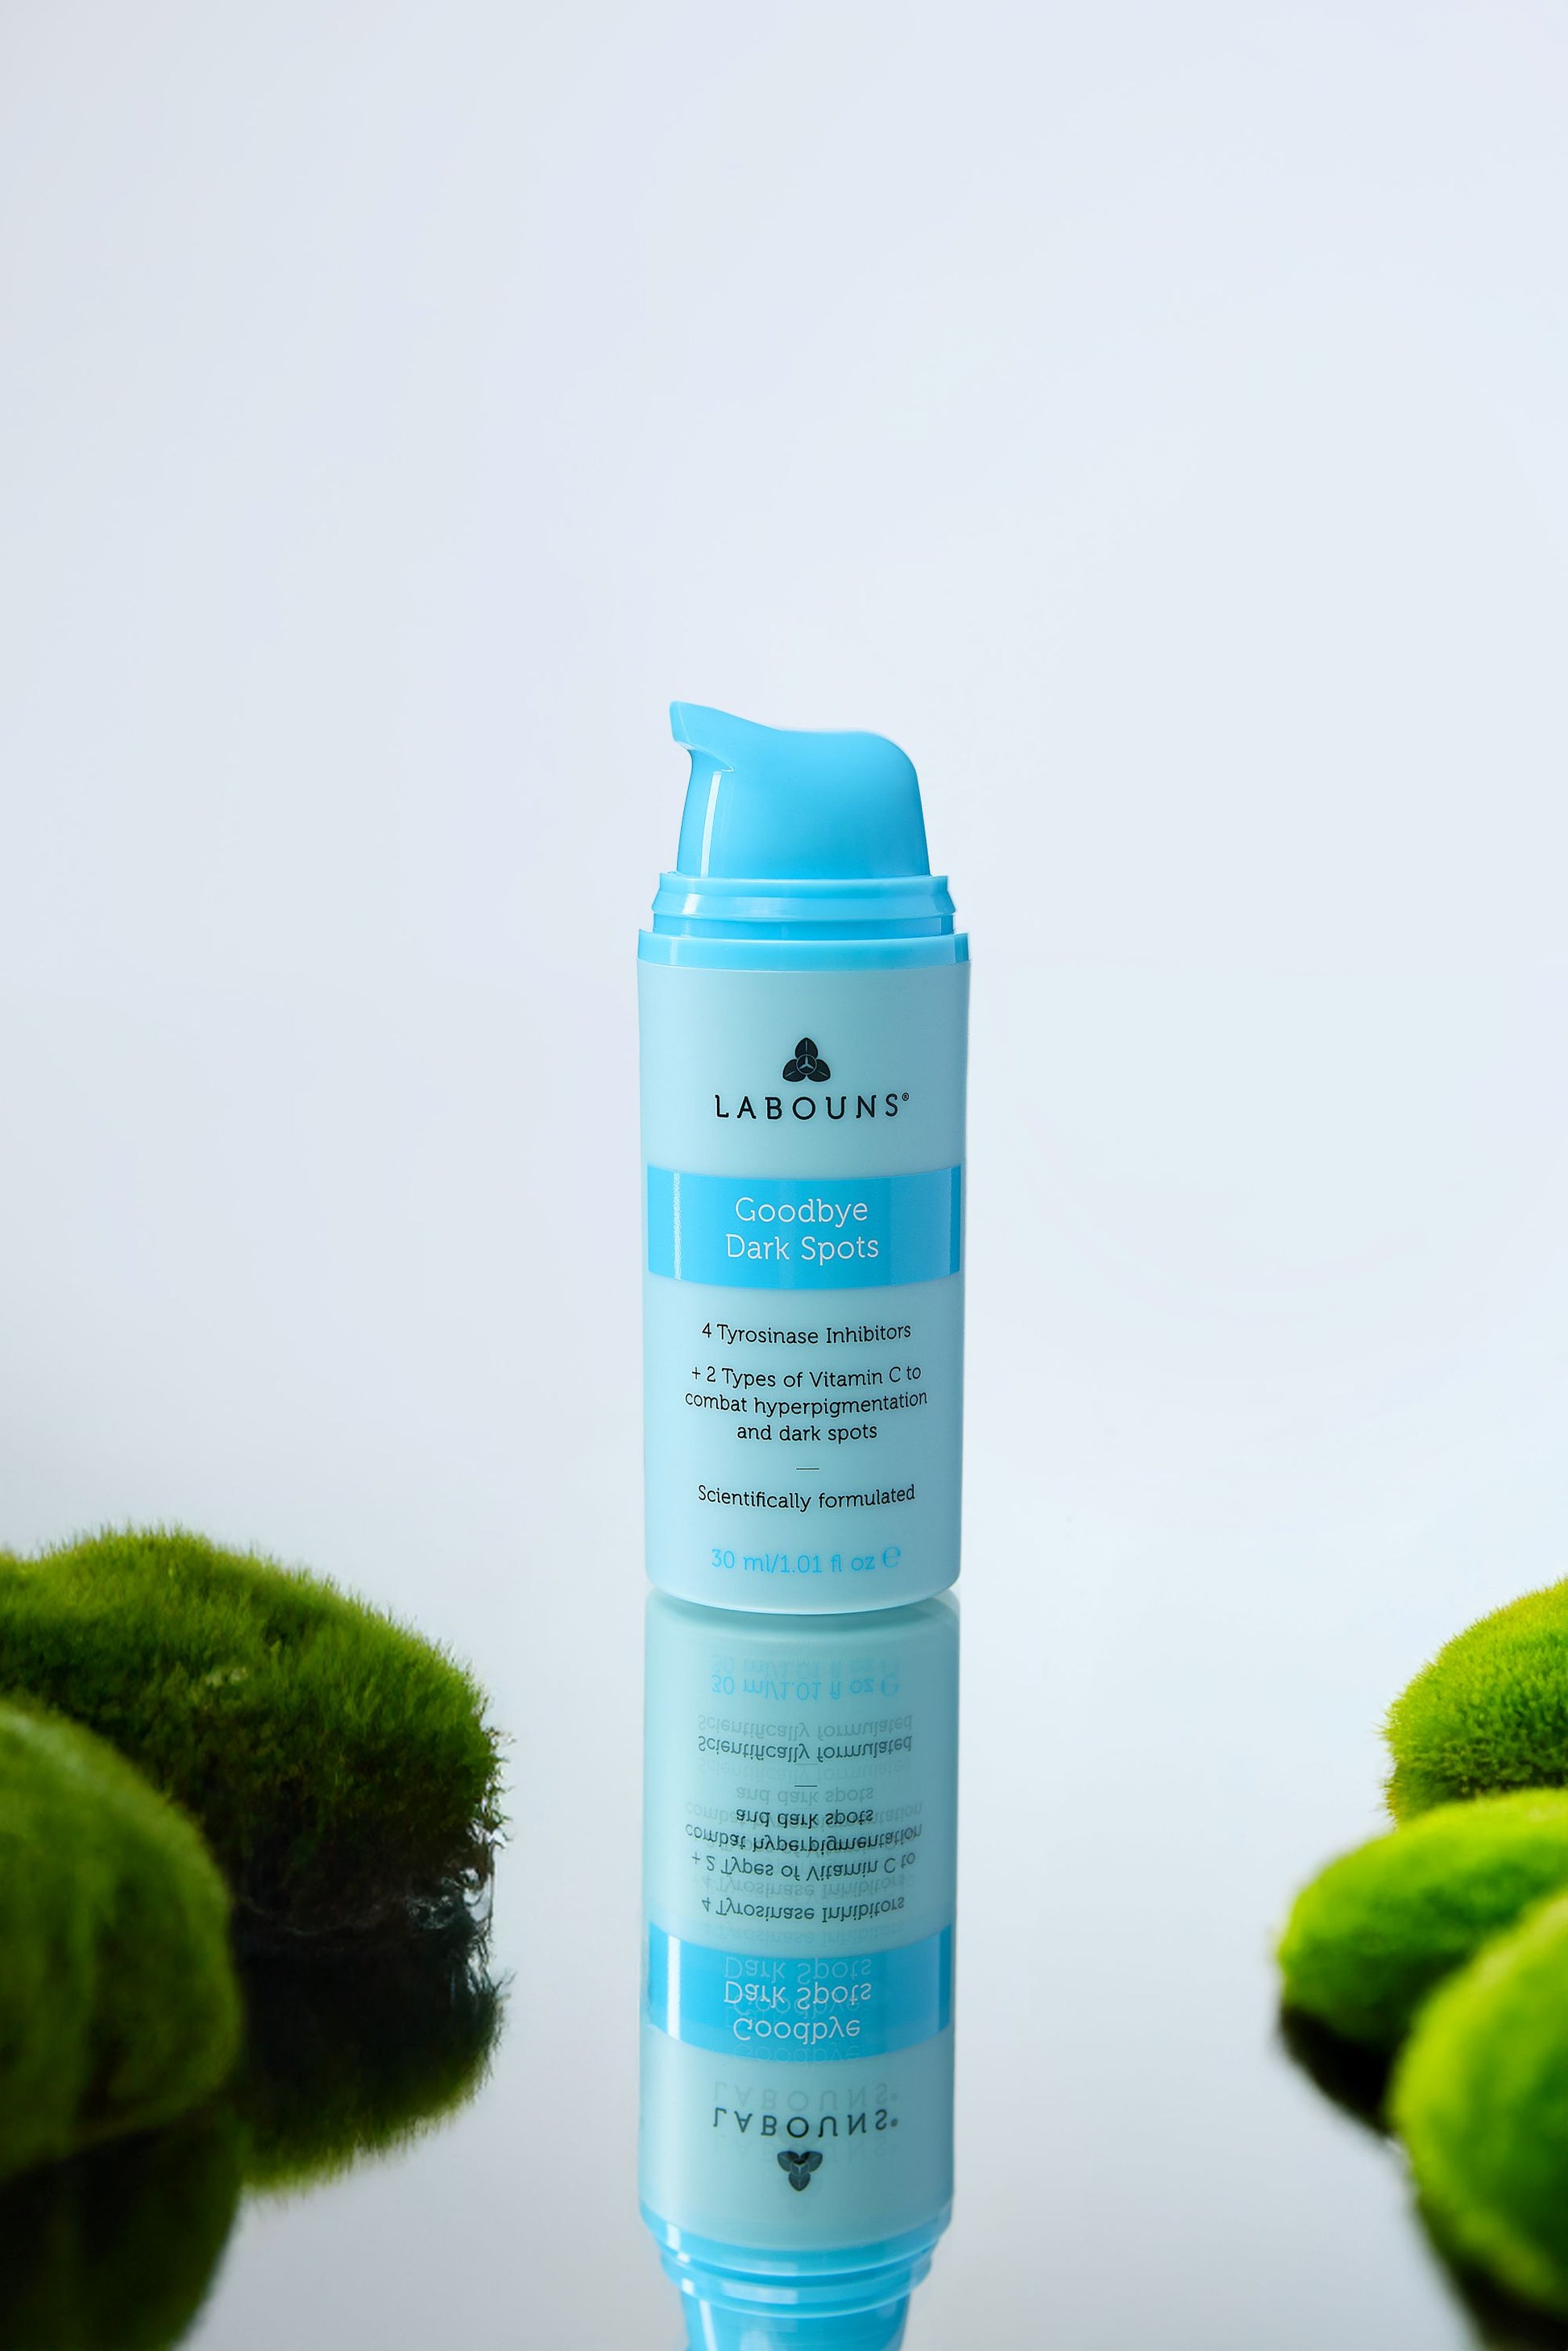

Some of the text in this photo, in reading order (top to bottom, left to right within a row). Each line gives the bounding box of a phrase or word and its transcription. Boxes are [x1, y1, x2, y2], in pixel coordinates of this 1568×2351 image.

[735, 1196, 868, 1228] Goodbye
[725, 1234, 879, 1266] Dark Spots
[702, 1323, 911, 1345] 4 Tyrosinase Inhibitors
[707, 1366, 716, 1383] 2
[721, 1368, 776, 1389] Types
[783, 1371, 803, 1387] of
[809, 1368, 883, 1388] Vitamin
[889, 1366, 902, 1383] C
[906, 1366, 922, 1380] to
[685, 1391, 928, 1418] combat hyperpigmentation
[736, 1423, 877, 1444] and dark spots
[698, 1484, 915, 1512] Scientifically formulated
[711, 1548, 735, 1569] 30
[743, 1554, 820, 1574] ml/1.01
[831, 1553, 842, 1573] fl
[851, 1555, 876, 1571] oz
